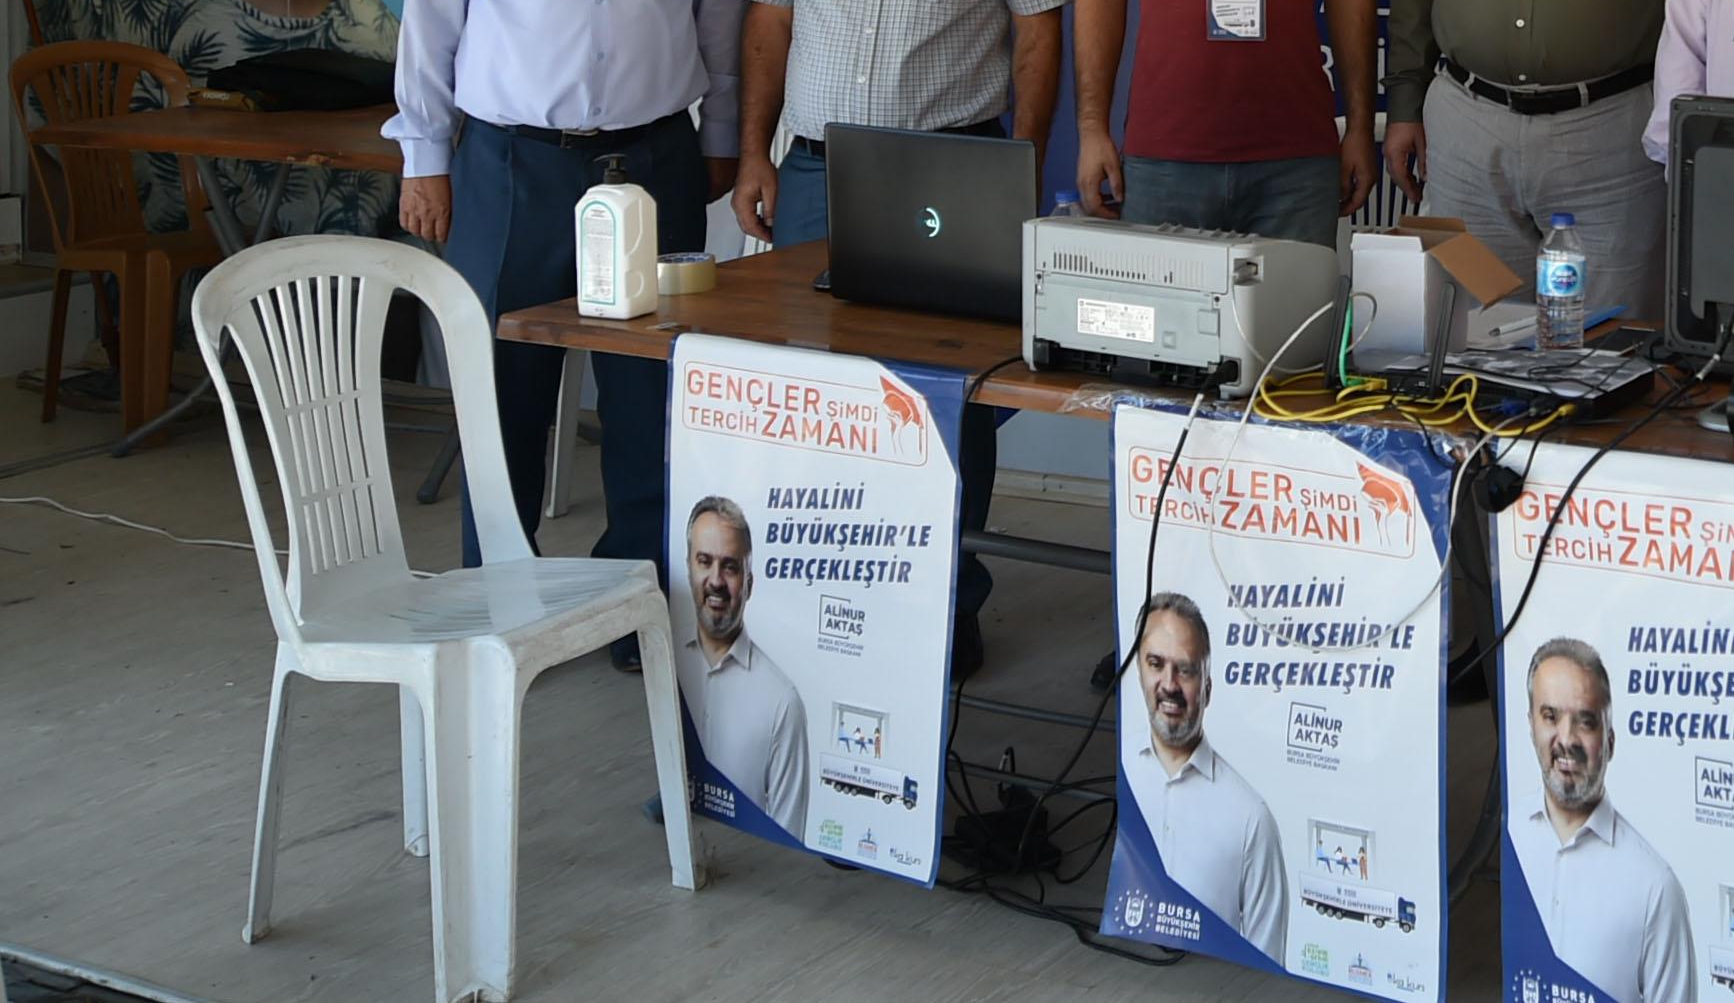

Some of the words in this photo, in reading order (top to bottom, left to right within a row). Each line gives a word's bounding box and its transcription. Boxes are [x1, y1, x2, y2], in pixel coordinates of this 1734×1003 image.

[687, 369, 822, 414] GENÇLER
[689, 406, 757, 434] TERCİH
[761, 410, 878, 454] ZAMANI
[1131, 455, 1293, 504] GENÇLER
[767, 482, 865, 510] HAYALİNİ
[1219, 500, 1361, 545] ZAMANI
[1518, 490, 1693, 538] GENÇLER
[765, 517, 932, 553] BÜYÜKŞEHİR'LE
[764, 555, 913, 588] GERÇEKLEŞTİR
[1227, 576, 1346, 608] HAYALİNİ
[824, 603, 866, 623] ALİNUR
[825, 617, 864, 637] AKTAŞ
[1224, 656, 1396, 695] GERÇEKLEŞTİR
[1293, 712, 1343, 734] ALİNUR
[1294, 728, 1339, 749] AKTAŞ
[704, 783, 735, 802] BURSA
[1158, 902, 1201, 923] BURSA
